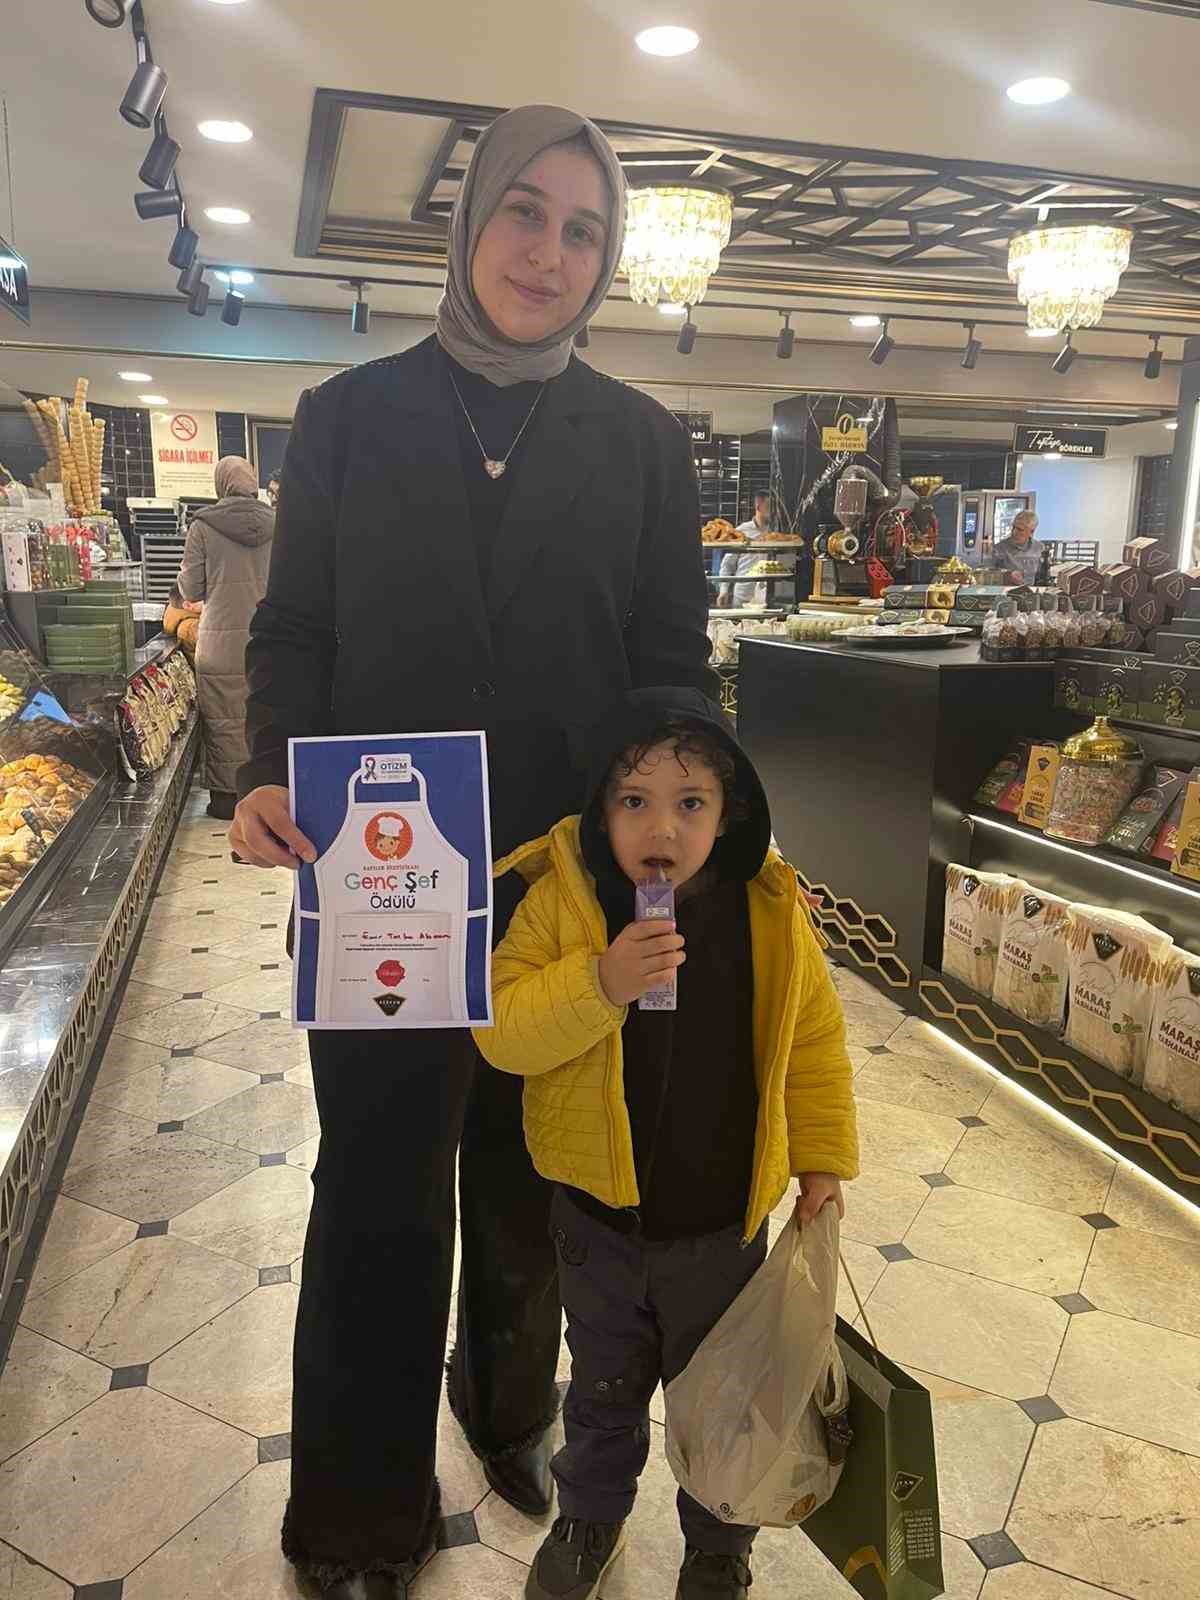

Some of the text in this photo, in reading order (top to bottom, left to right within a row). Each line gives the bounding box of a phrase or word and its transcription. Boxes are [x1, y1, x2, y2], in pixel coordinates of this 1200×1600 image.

[159, 448, 214, 464] SİGARA İÇİLMEZ
[344, 869, 439, 893] Genç Şef
[370, 892, 416, 909] Ödülü
[1003, 941, 1033, 965] MARAŞ
[1074, 984, 1112, 1012] MARAŞ
[1160, 1021, 1200, 1053] MARAŞ
